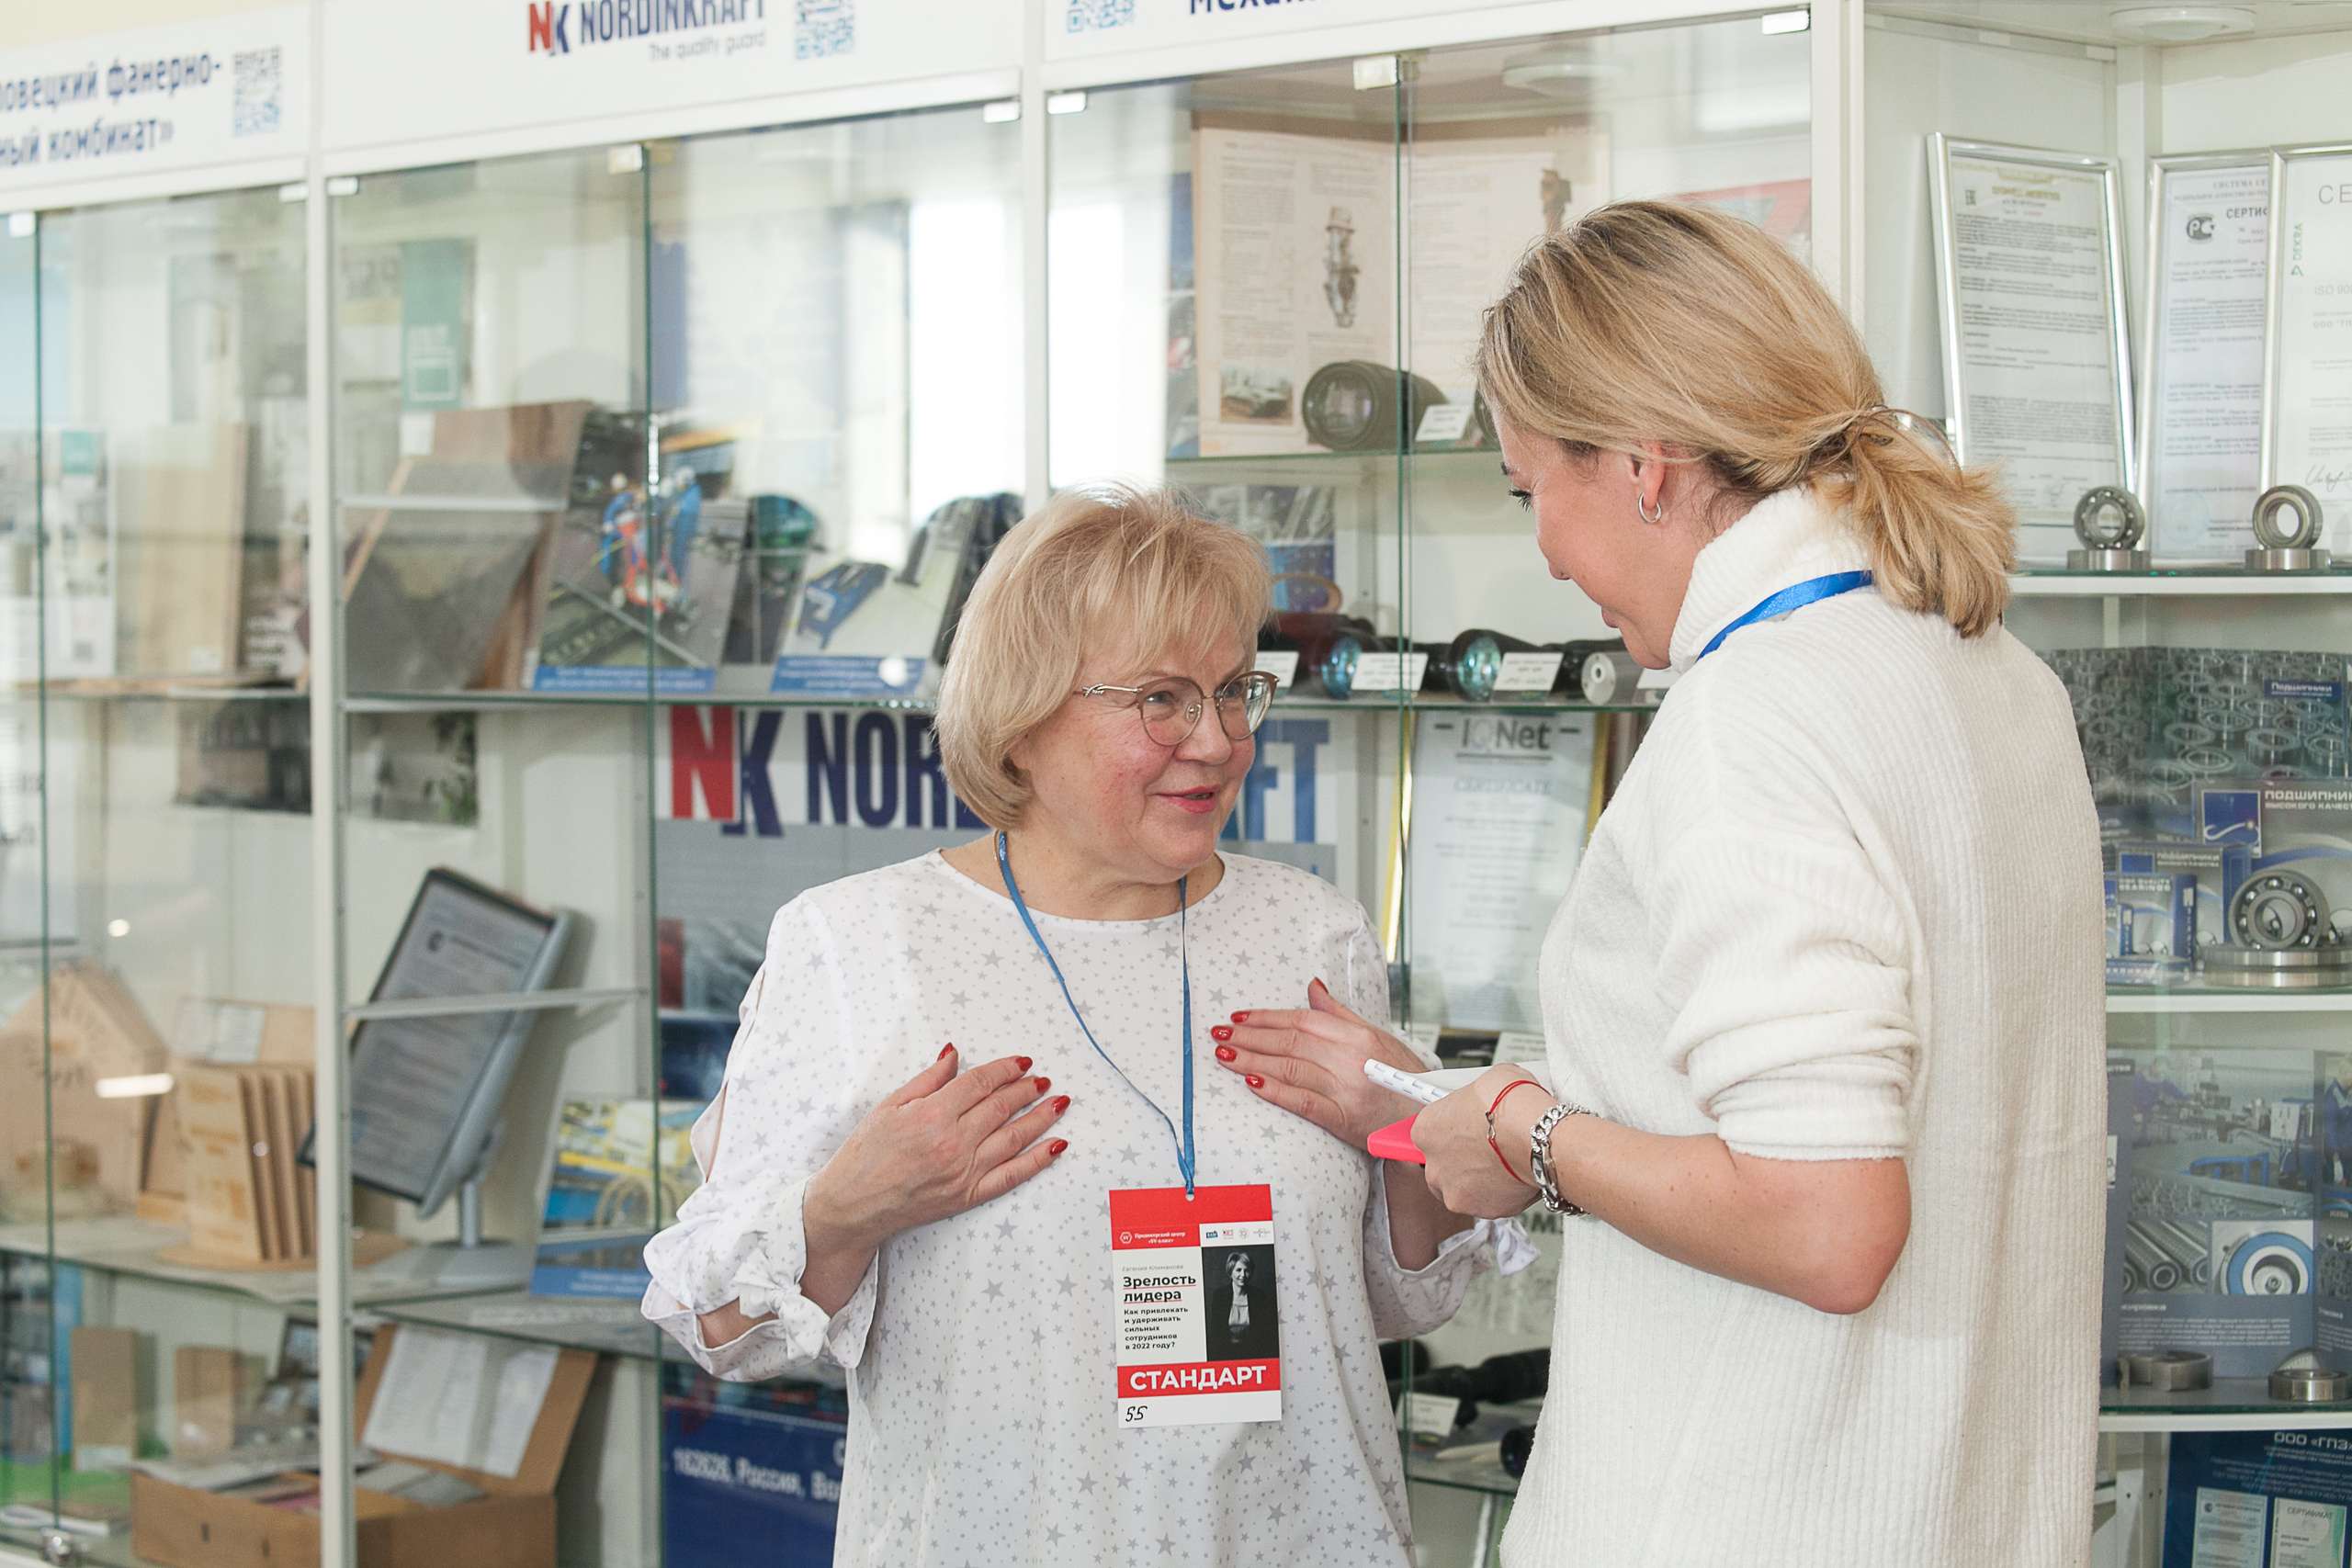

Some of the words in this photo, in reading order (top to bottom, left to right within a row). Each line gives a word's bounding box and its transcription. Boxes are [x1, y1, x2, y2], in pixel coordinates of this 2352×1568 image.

[529, 2, 570, 56] NK
[649, 43, 670, 61] The
[675, 36, 719, 59] quality
[726, 31, 766, 55] guard
[0, 62, 98, 111] овецкий
[107, 55, 220, 105] фанерно-
[49, 116, 175, 164] комбинат»
[2293, 222, 2303, 262] DEKRA
[2314, 285, 2335, 295] ISO
[671, 706, 783, 836] NK
[807, 711, 988, 829] NOR
[1233, 718, 1329, 843] FT
[1123, 1276, 1196, 1289] Зрелость
[1124, 1291, 1182, 1303] лидера
[1132, 1316, 1181, 1325] удерживать
[1140, 1307, 1188, 1315] привлекать
[1125, 1334, 1177, 1342] сотрудников
[1130, 1365, 1266, 1391] СТАНДАРТ
[1125, 1405, 1148, 1422] 55
[2274, 1432, 2307, 1445] ООО
[736, 1457, 806, 1498] Россия,
[2287, 1506, 2333, 1520] СЕРТИФИКАТ
